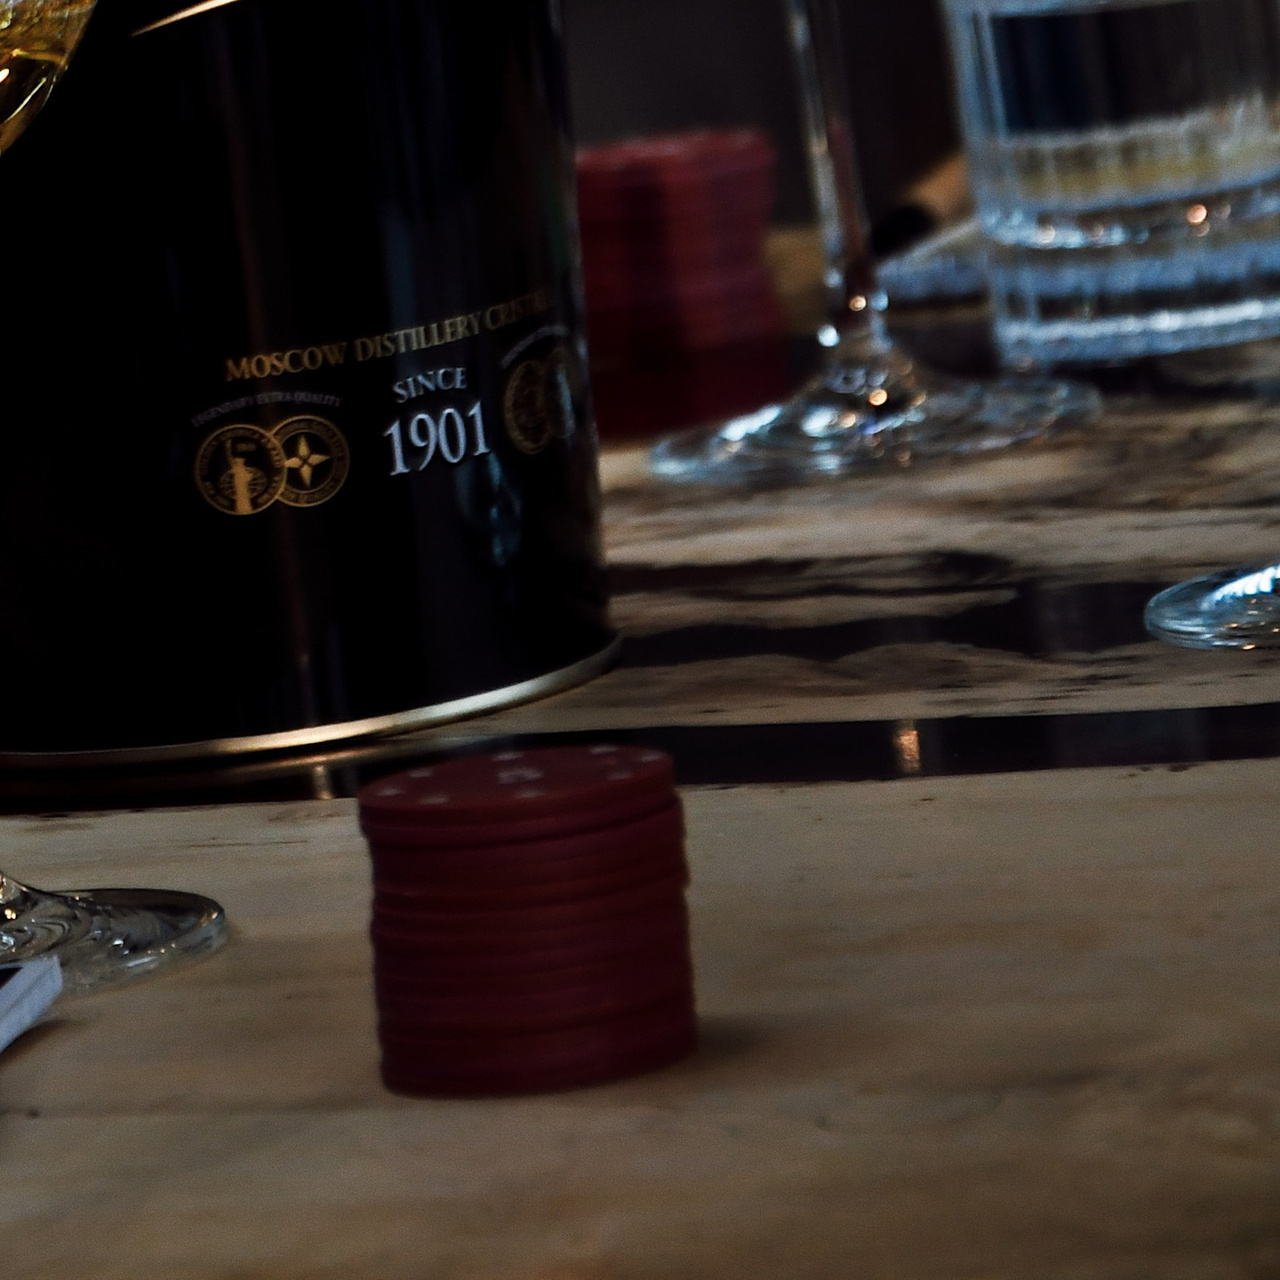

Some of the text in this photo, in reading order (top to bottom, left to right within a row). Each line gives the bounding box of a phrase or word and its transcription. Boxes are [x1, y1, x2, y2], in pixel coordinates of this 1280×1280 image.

[224, 341, 348, 382] MOSCOW
[352, 310, 482, 363] DISTILLERY
[391, 366, 469, 403] SINCE
[382, 399, 491, 477] 1901
